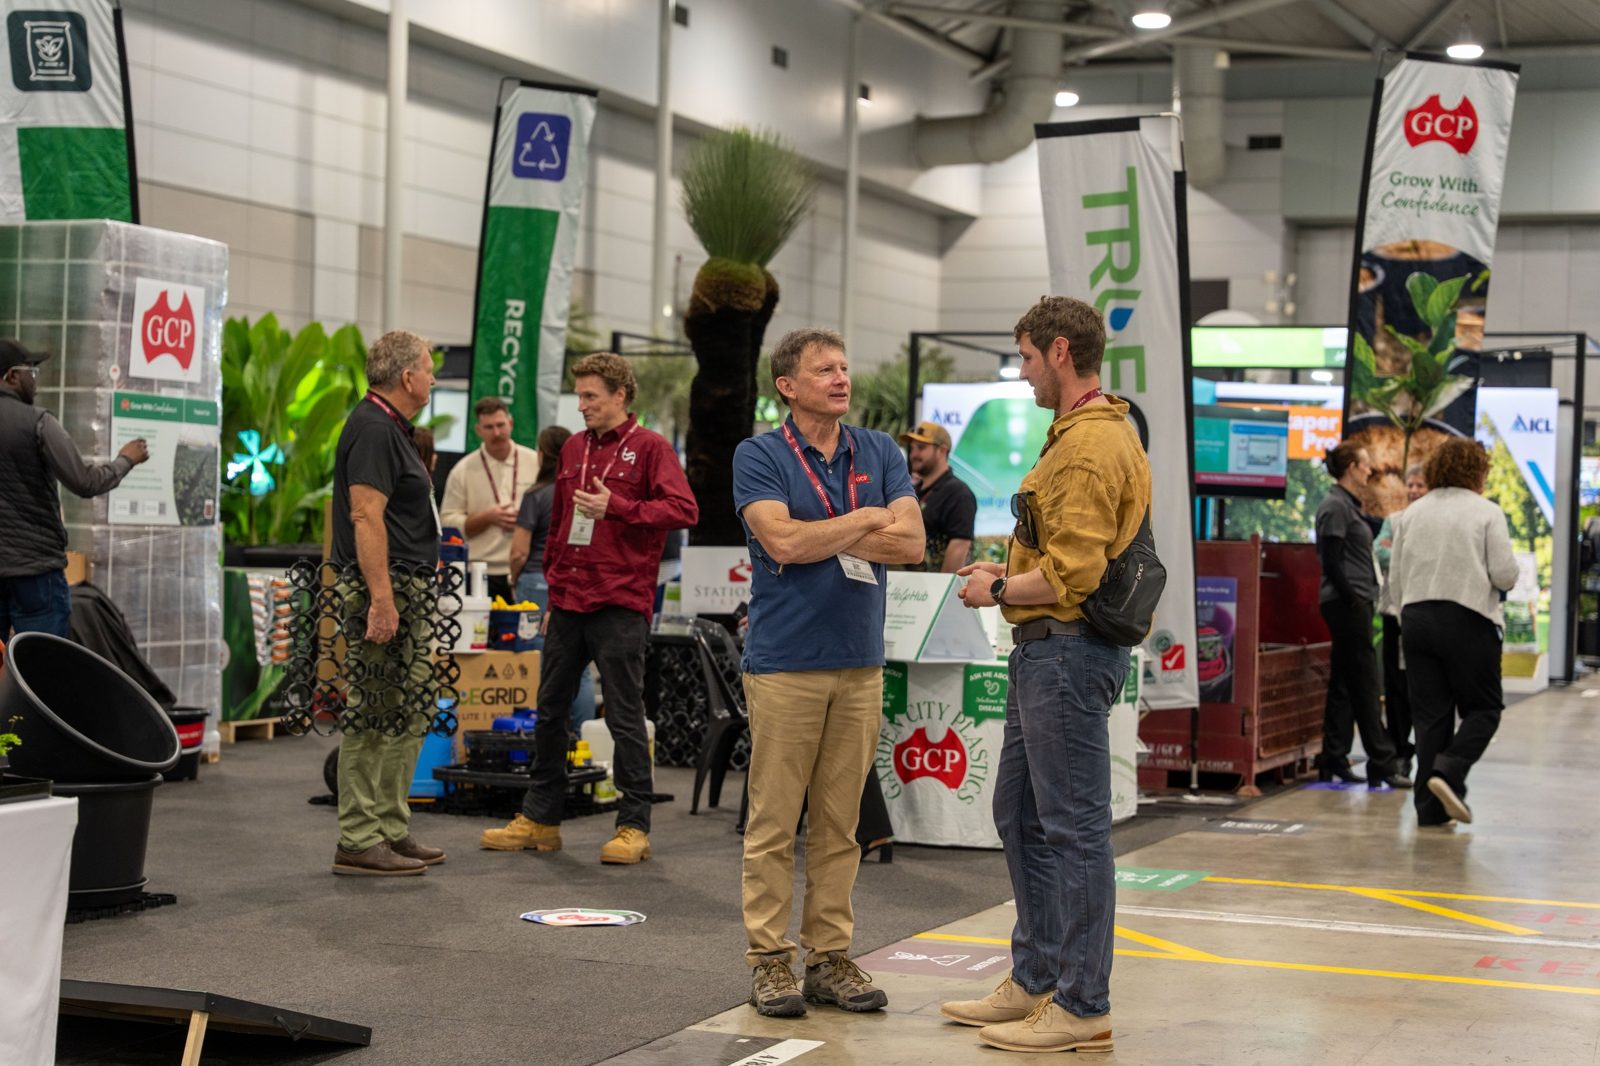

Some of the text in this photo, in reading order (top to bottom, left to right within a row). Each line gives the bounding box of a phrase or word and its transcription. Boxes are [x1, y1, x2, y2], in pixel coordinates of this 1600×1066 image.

[1411, 111, 1473, 139] GCP
[1389, 170, 1478, 193] Grow With
[1380, 190, 1480, 218] Confidence
[146, 314, 192, 349] GCP
[498, 299, 526, 405] RECYCL
[1529, 418, 1554, 433] ICL
[694, 586, 752, 598] STATIO
[970, 671, 1008, 681] ASK ME ABO
[978, 704, 1004, 712] DISEASE
[875, 700, 989, 805] GARDEN CITY PLASTICS
[901, 746, 961, 773] GCP
[1472, 955, 1600, 976] KE
